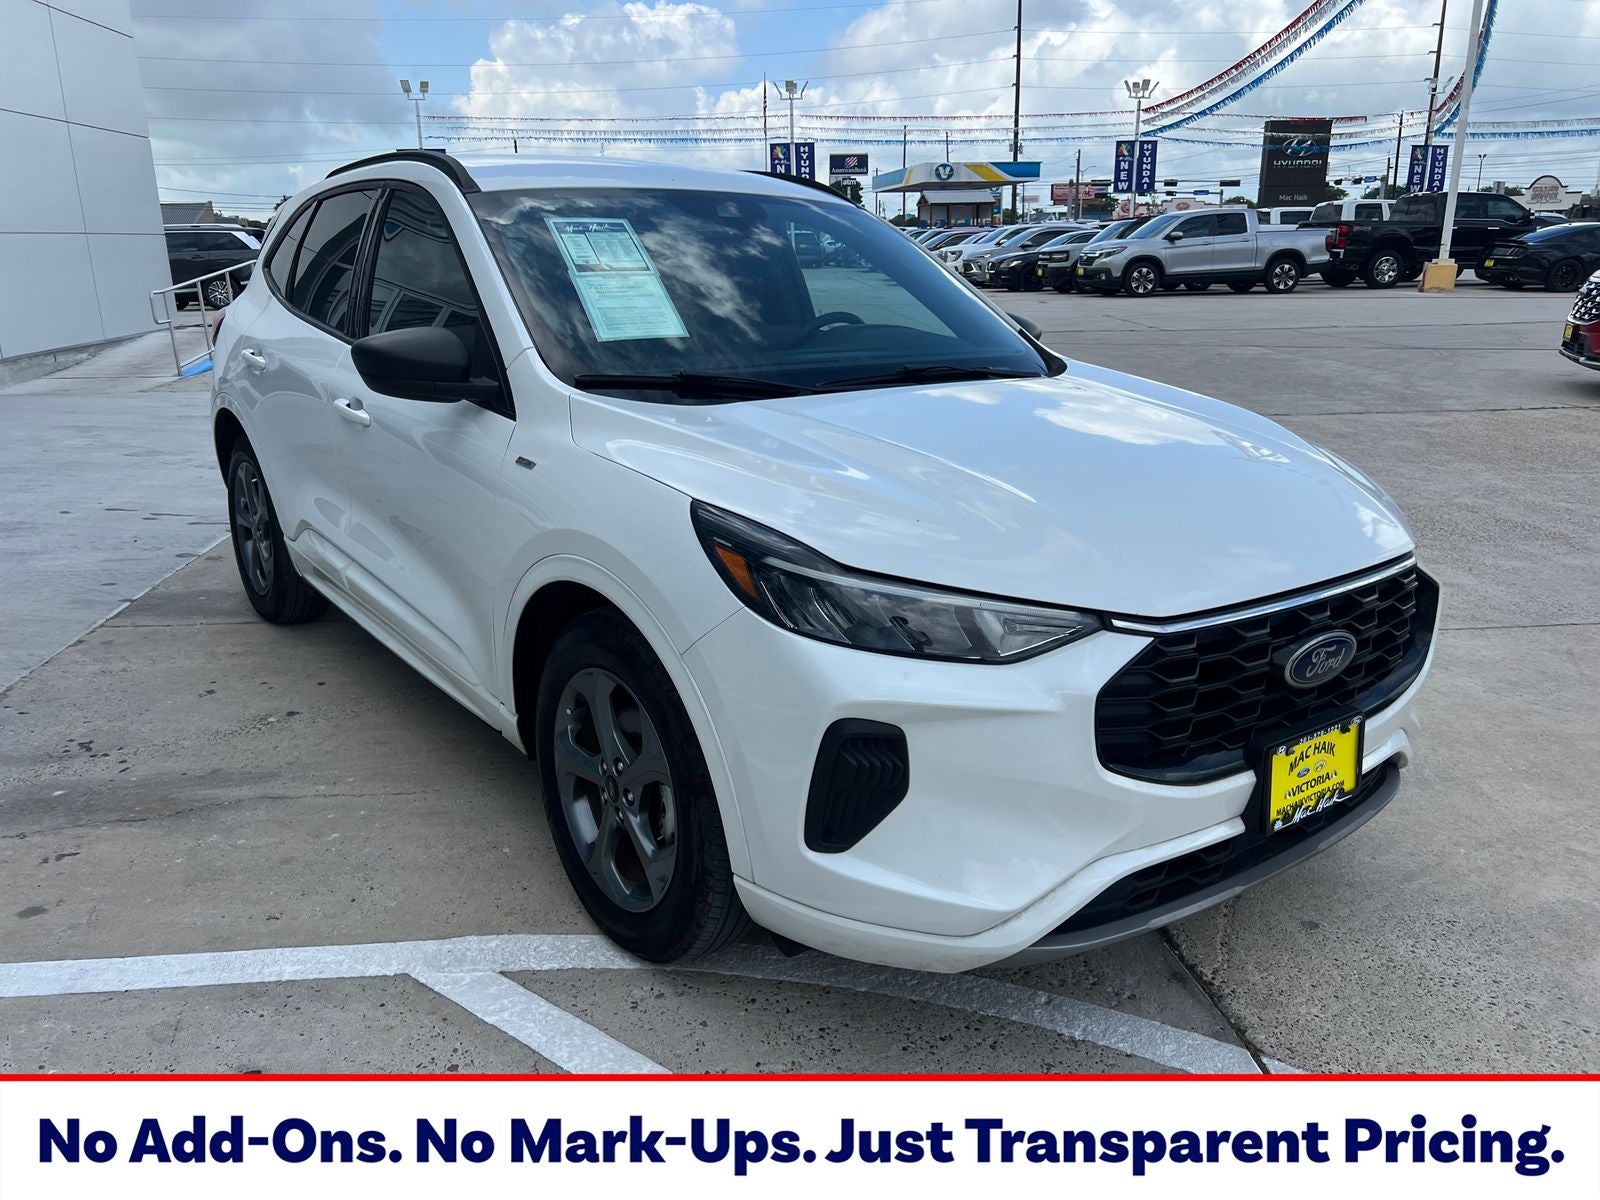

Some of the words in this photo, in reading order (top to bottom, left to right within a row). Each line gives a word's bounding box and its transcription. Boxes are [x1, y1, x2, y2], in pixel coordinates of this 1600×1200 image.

[1117, 161, 1129, 190] NEW
[1141, 143, 1152, 190] HYUNDAI
[1273, 159, 1322, 168] HYUNDAI
[1410, 164, 1423, 193] NEW
[1305, 644, 1346, 678] Ford
[1288, 744, 1312, 776] MAC
[1312, 740, 1336, 757] HAIK
[1291, 772, 1331, 797] VICTORIA
[1292, 805, 1316, 824] Mac
